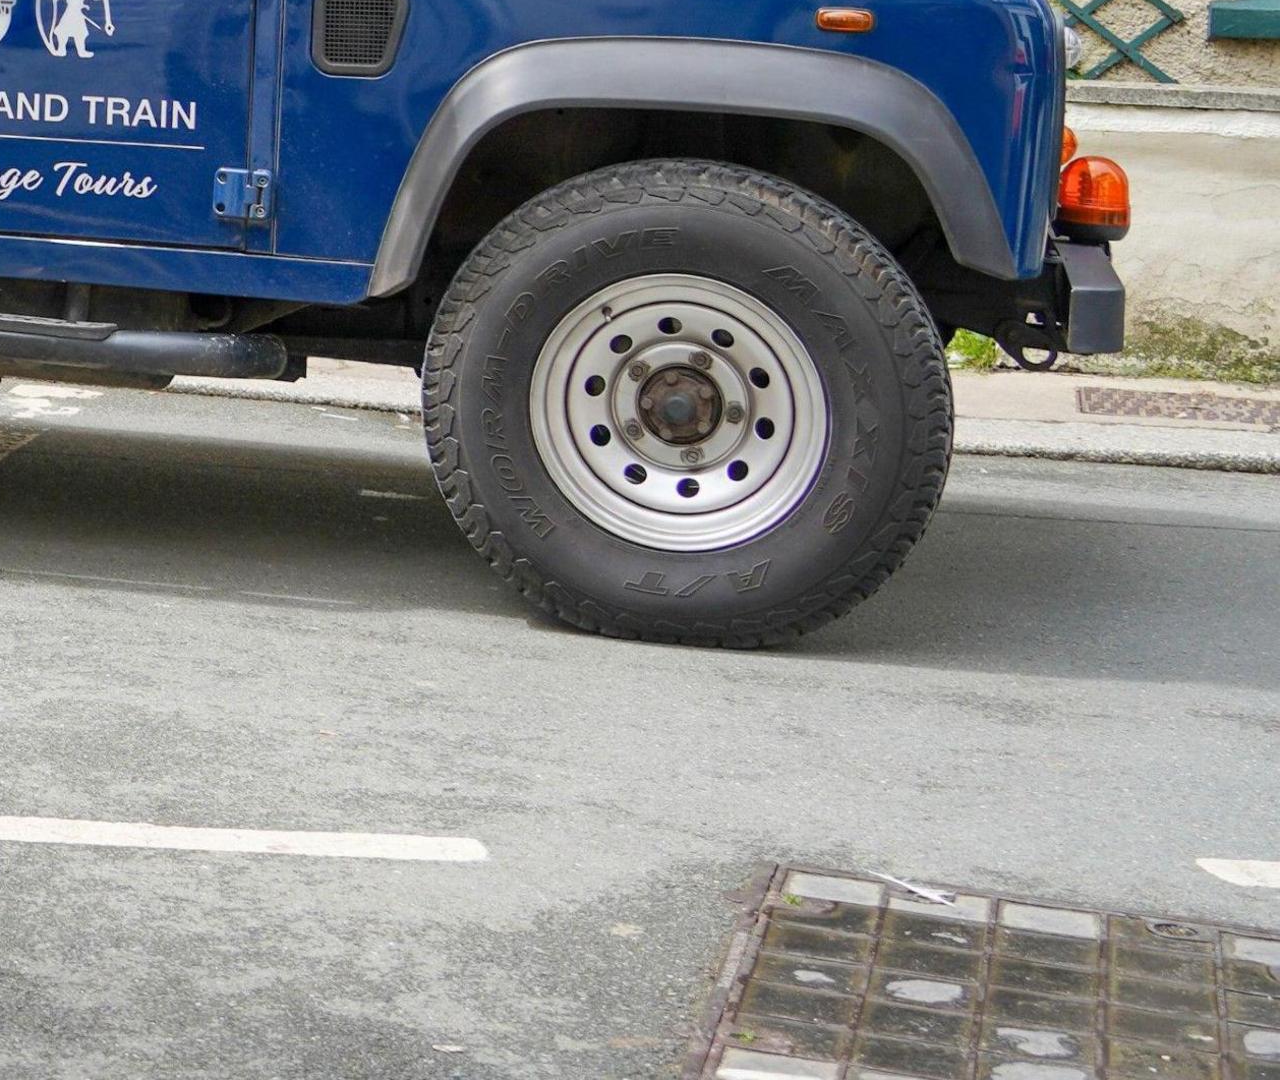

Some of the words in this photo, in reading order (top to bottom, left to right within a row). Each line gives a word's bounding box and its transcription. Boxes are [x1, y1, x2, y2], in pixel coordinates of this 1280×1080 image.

[81, 94, 197, 130] TRAIN
[53, 160, 158, 199] Tours
[762, 264, 880, 536] MAXXIS
[623, 558, 773, 599] A/T
